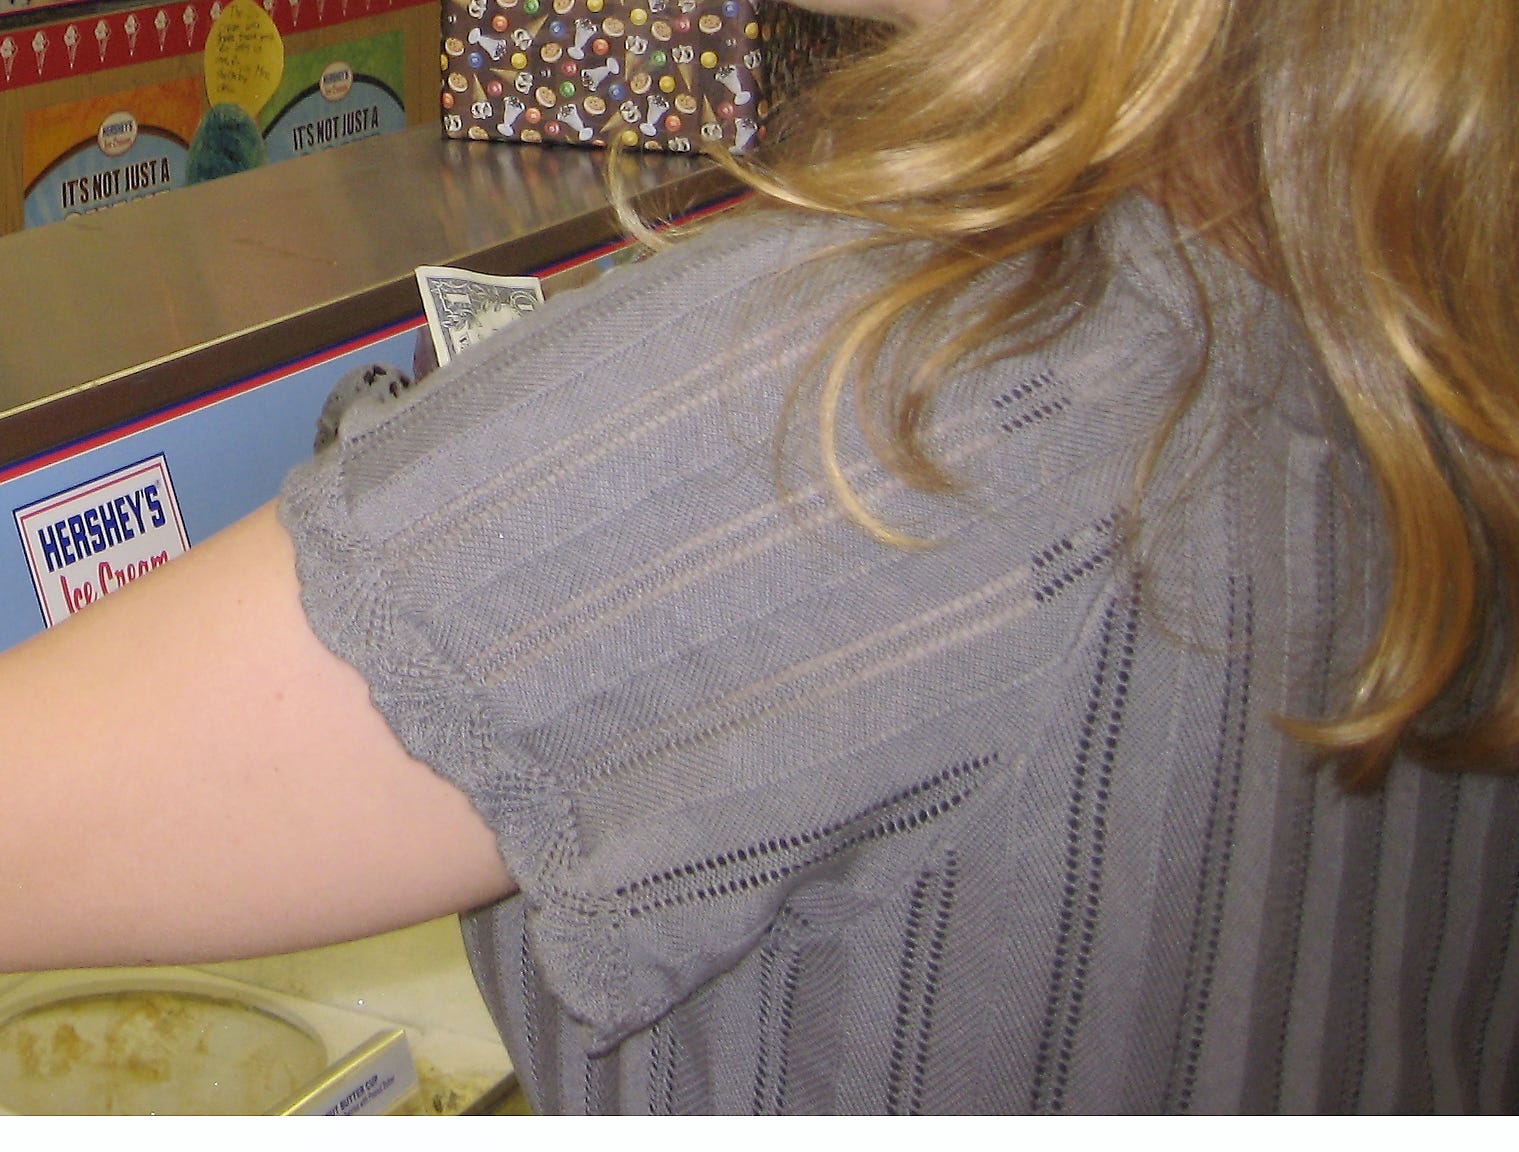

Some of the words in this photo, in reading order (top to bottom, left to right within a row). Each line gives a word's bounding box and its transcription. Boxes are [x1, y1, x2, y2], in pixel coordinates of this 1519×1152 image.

[293, 123, 314, 151] IT'S
[317, 118, 339, 144] NOT
[343, 111, 366, 138] JUST
[369, 106, 378, 128] A
[61, 180, 88, 208] IT'S
[93, 171, 120, 201] NOT
[125, 160, 156, 194] JUST
[160, 157, 170, 182] A
[37, 483, 166, 573] HERSHEY'S
[60, 575, 99, 615] Ice
